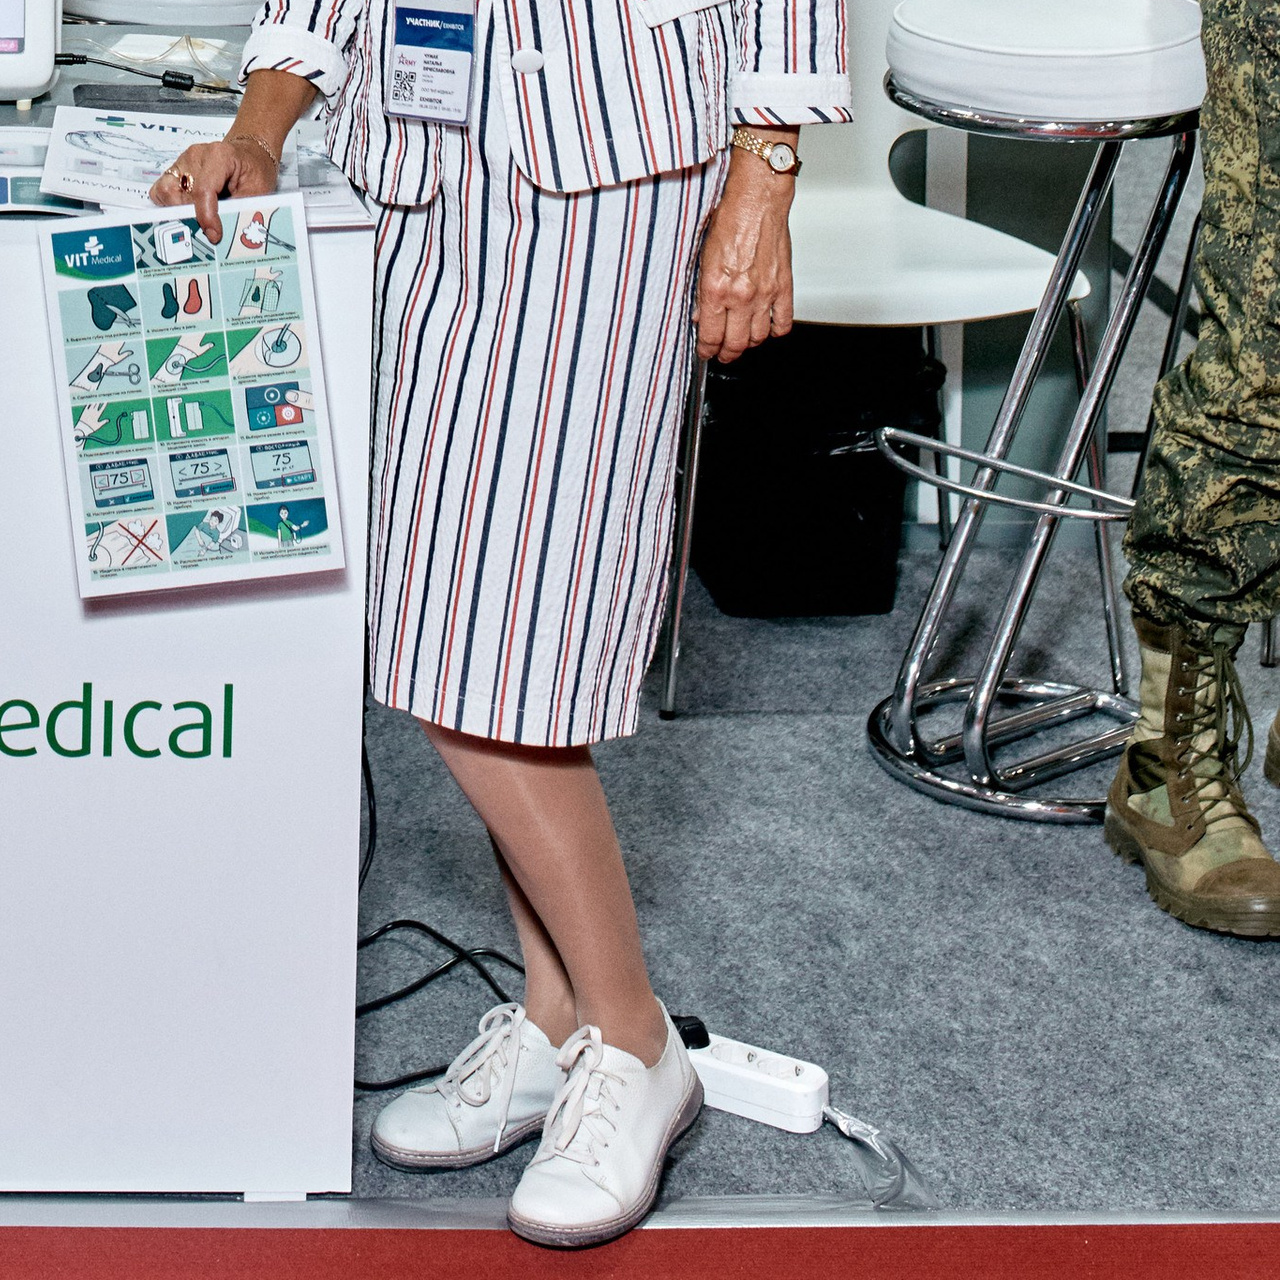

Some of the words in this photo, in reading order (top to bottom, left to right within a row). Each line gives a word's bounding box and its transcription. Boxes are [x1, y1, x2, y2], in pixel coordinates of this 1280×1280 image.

[140, 122, 182, 133] VIT
[64, 252, 89, 268] VIT
[91, 254, 122, 265] Medical
[272, 452, 291, 466] 75
[191, 462, 210, 474] 75
[110, 472, 128, 484] 75
